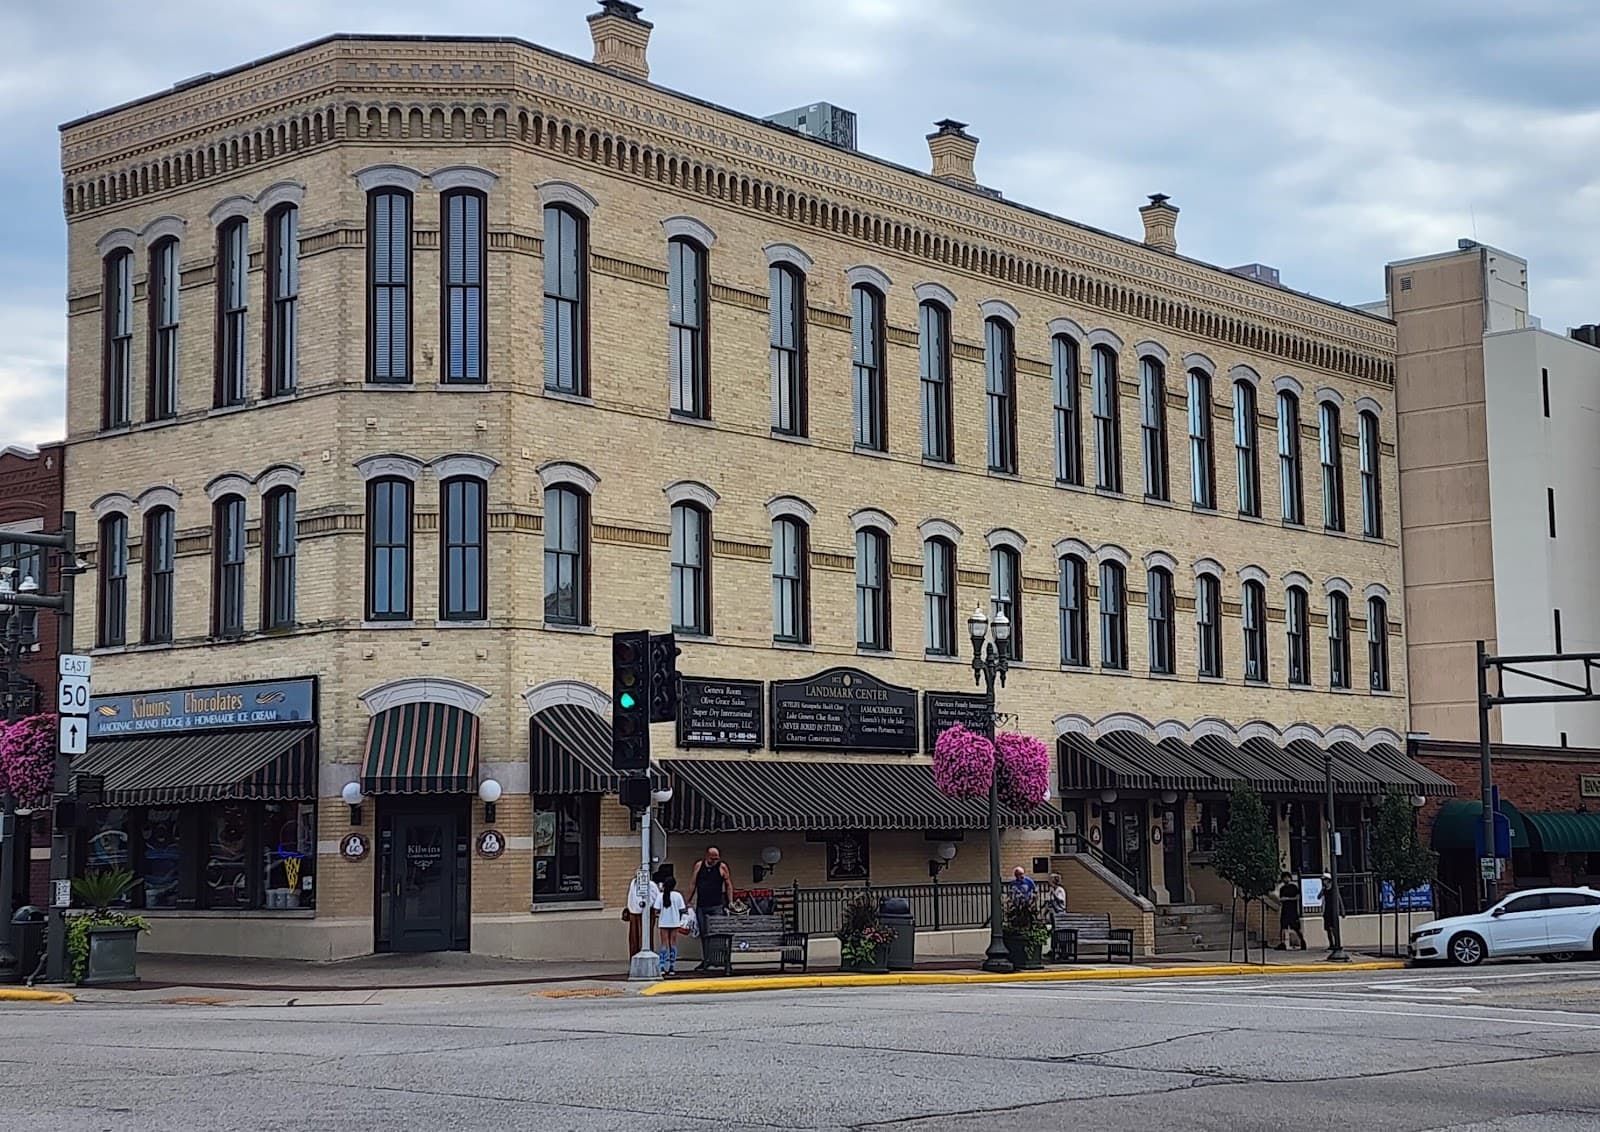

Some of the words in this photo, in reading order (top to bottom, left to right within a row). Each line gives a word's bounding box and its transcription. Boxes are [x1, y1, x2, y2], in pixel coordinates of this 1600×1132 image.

[64, 658, 87, 672] EAST
[63, 685, 87, 706] 50
[704, 686, 724, 694] Geneva
[726, 686, 742, 695] Room
[806, 686, 854, 698] LANDMARK
[856, 688, 888, 700] CENTER
[184, 691, 242, 714] Chocolates
[700, 696, 714, 705] Olive
[692, 708, 708, 718] Super
[709, 708, 720, 718] Dry
[720, 709, 752, 718] International
[99, 721, 133, 732] MACKINAC
[135, 719, 158, 730] ISLAND
[161, 717, 184, 728] FUDGE
[194, 712, 234, 725] HOMEMADE
[238, 712, 248, 722] ICE
[251, 710, 276, 720] CREAM
[692, 719, 716, 728] Blackrock
[742, 720, 753, 729] LLC
[782, 722, 800, 730] NEVER
[786, 732, 806, 742] Charter
[808, 734, 841, 742] Construction
[408, 844, 440, 854] Kilwins
